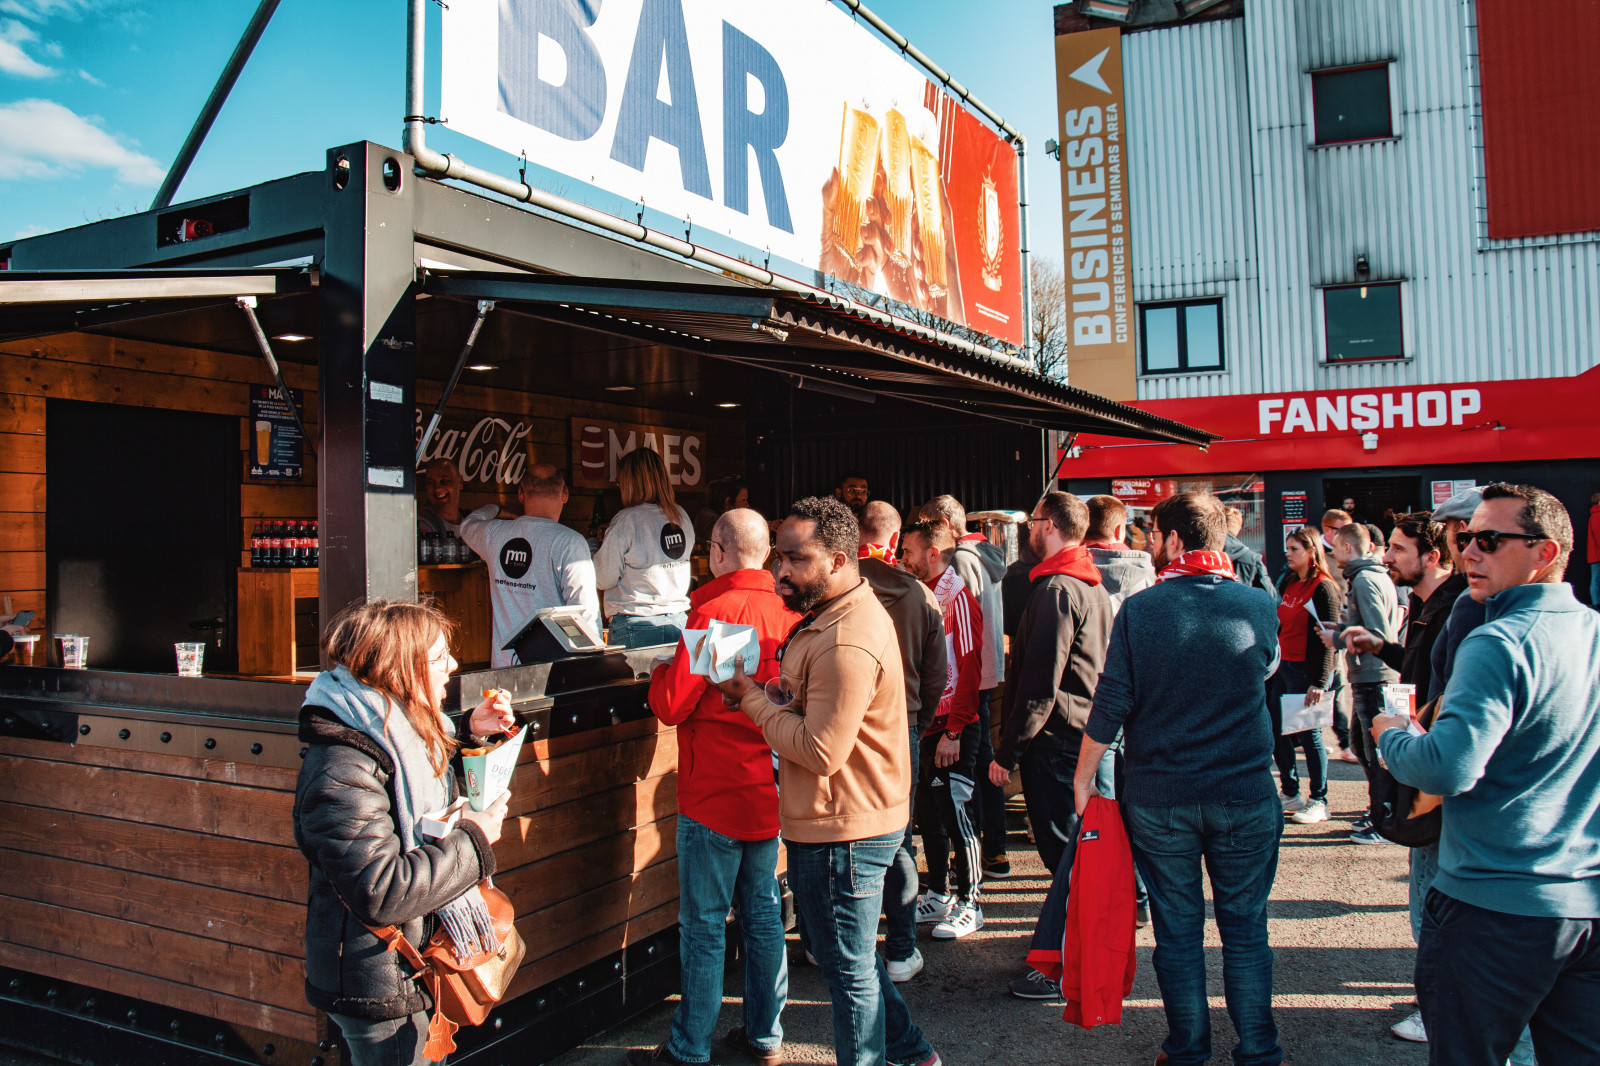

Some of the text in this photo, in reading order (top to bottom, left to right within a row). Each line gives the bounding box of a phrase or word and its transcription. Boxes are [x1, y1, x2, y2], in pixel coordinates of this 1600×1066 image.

[497, 0, 794, 235] BAR
[1065, 105, 1112, 346] BUSINESS
[1106, 103, 1128, 343] CONFERENCES & SEMINARS AREA
[1258, 389, 1481, 434] FANSHOP
